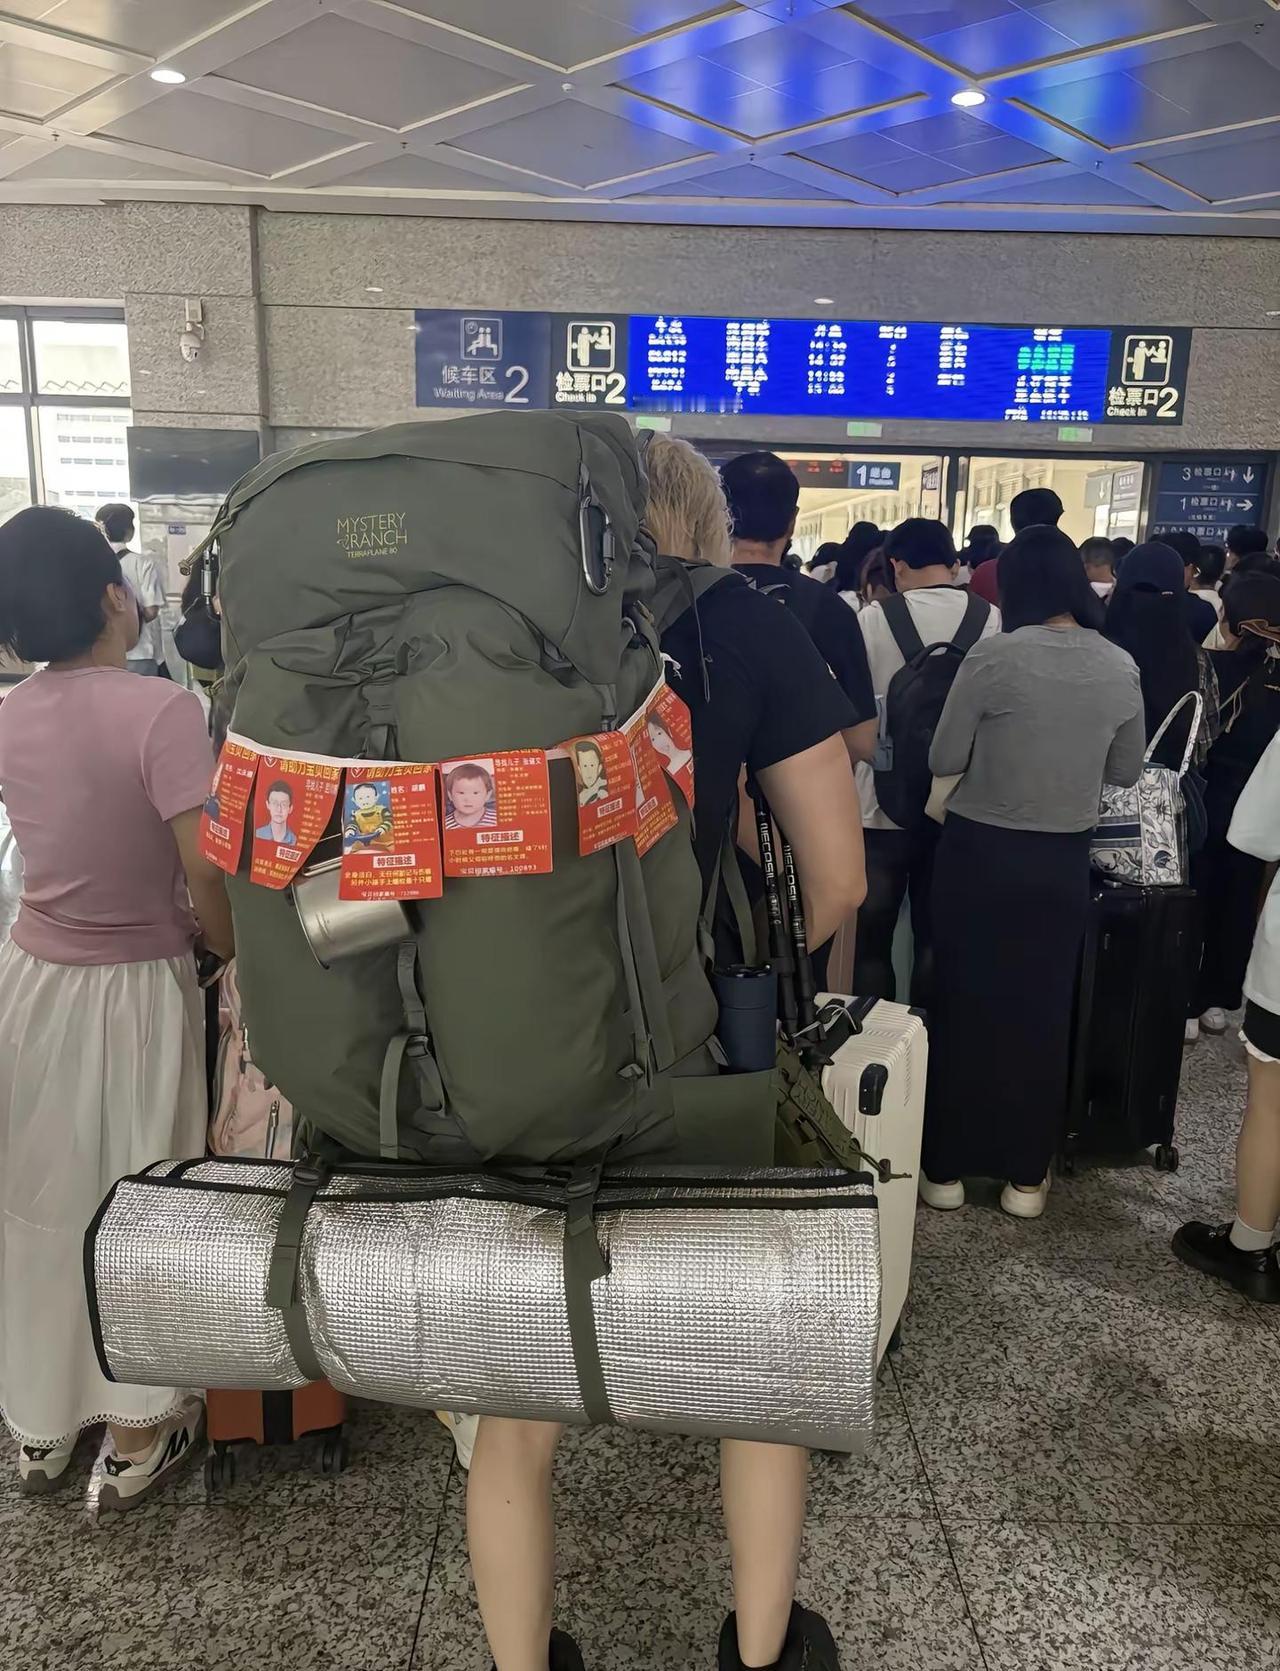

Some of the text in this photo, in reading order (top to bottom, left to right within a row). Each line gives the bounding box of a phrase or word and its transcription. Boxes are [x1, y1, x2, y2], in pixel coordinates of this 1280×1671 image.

[433, 387, 475, 401] Waiting
[442, 365, 529, 403] 候车区 2
[555, 371, 626, 403] 检票口 2
[1108, 387, 1179, 417] 检票口 2
[857, 464, 867, 486] 1
[1182, 467, 1191, 481] 3
[1180, 497, 1187, 510] 1
[337, 512, 406, 534] MYSTERY
[350, 529, 407, 549] RANCH
